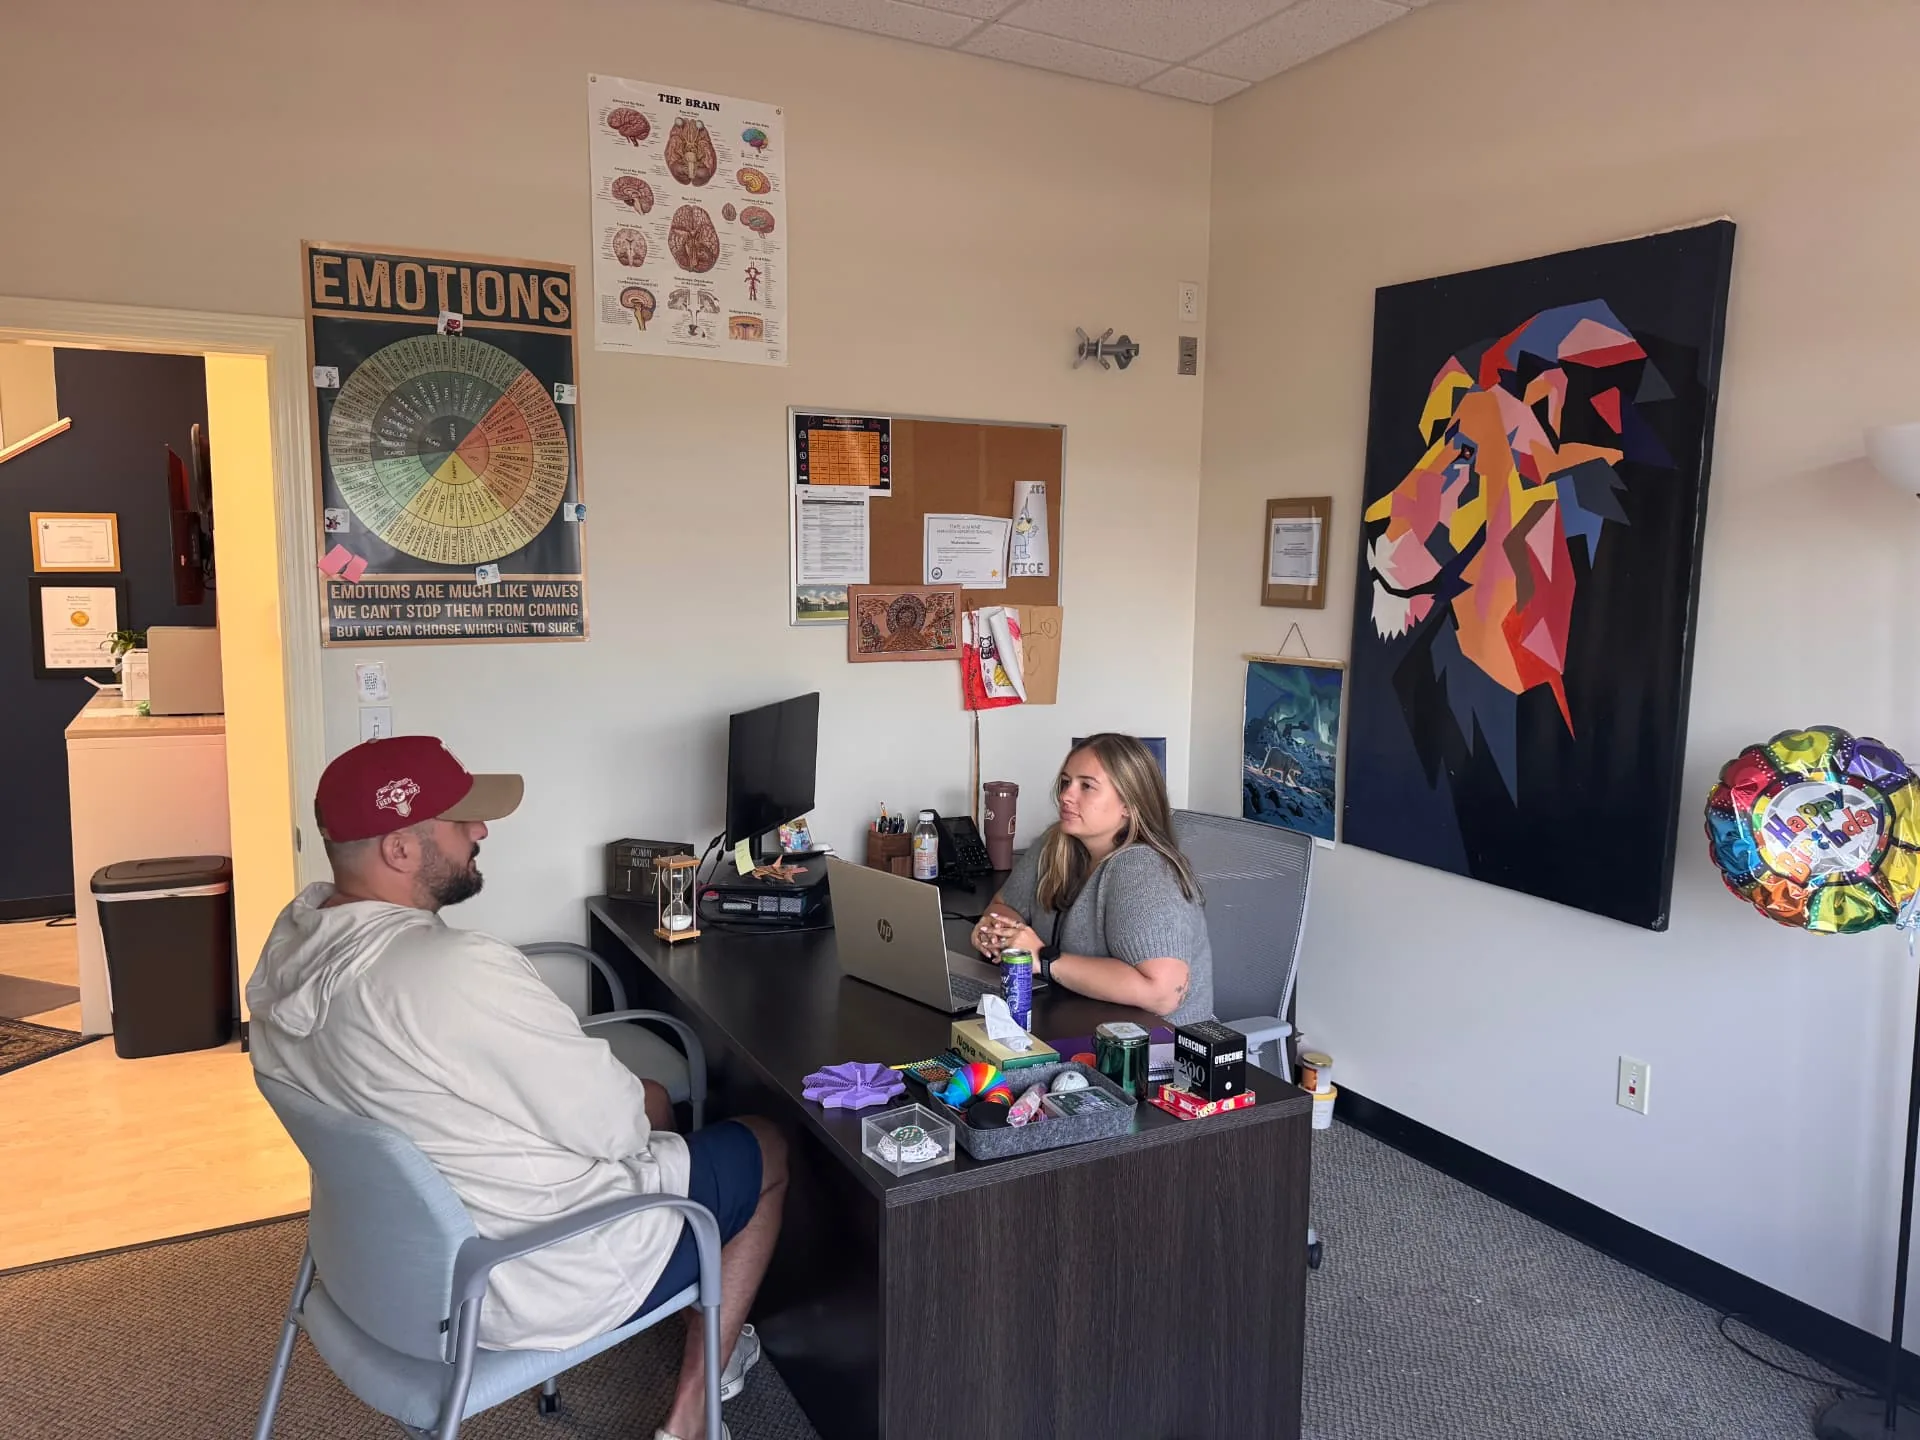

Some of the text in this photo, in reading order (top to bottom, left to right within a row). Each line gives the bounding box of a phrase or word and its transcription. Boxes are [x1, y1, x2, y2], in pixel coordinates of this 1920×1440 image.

[658, 94, 681, 105] THE
[686, 99, 720, 112] BRAIN
[313, 255, 570, 323] EMOTIONS
[331, 583, 579, 600] EMOTIONS ARE MUCH LIKE WAVES
[334, 603, 579, 619] WE CAN'T STOP THEM FROM COMING
[336, 625, 360, 637] BUT
[365, 625, 383, 637] WE
[387, 624, 411, 636] CAN
[415, 624, 460, 636] CHOOSE
[465, 623, 503, 635] WHICH
[506, 623, 528, 634] ONE
[531, 622, 545, 634] TO
[1764, 789, 1845, 849] Happy
[631, 847, 652, 857] MONDAY
[632, 858, 650, 868] AUGUST
[625, 869, 659, 894] 1 7
[880, 919, 891, 942] hp
[956, 1034, 976, 1057] Nova
[1178, 1034, 1208, 1057] OVERCOME
[1214, 1050, 1244, 1065] OVERCOME
